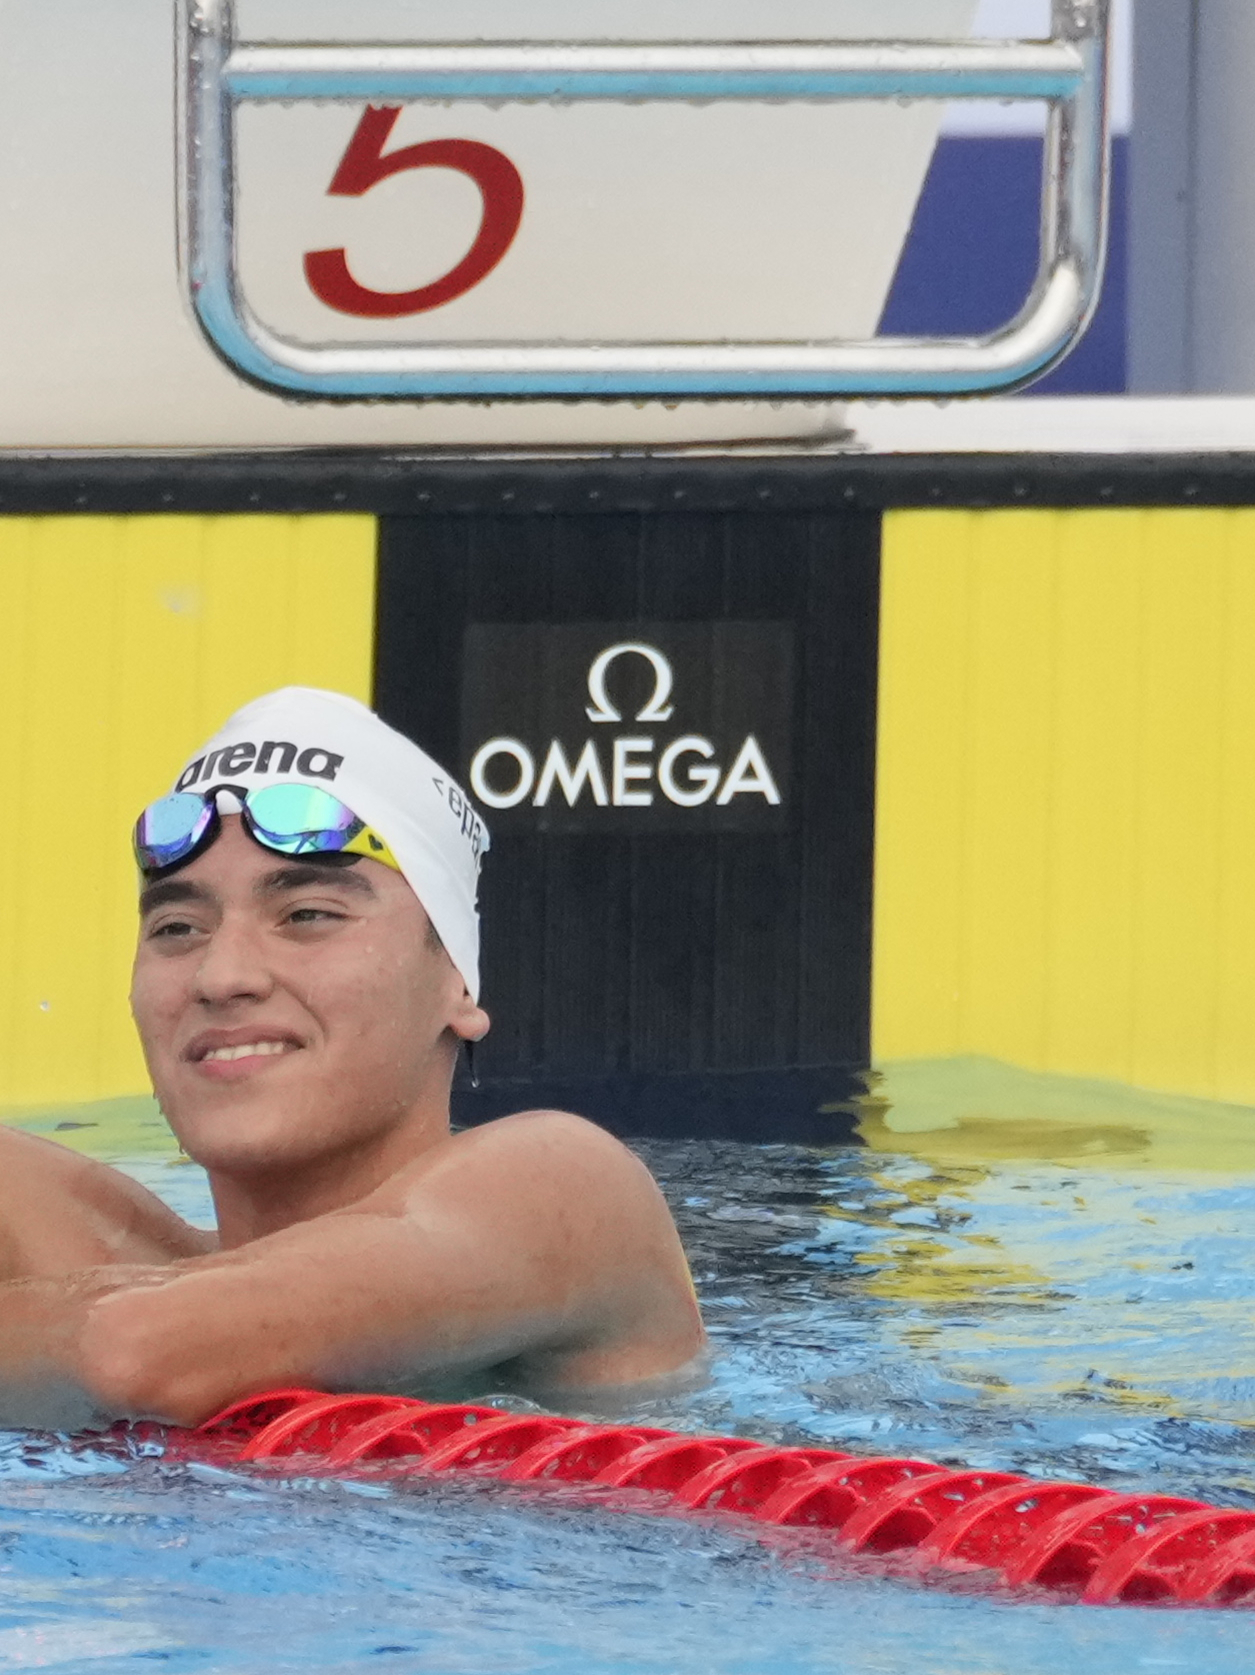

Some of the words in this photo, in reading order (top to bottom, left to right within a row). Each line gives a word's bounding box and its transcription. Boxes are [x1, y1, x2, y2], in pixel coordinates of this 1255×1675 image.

[302, 103, 524, 319] 5
[175, 740, 345, 793] arena
[470, 735, 781, 809] OMEGA
